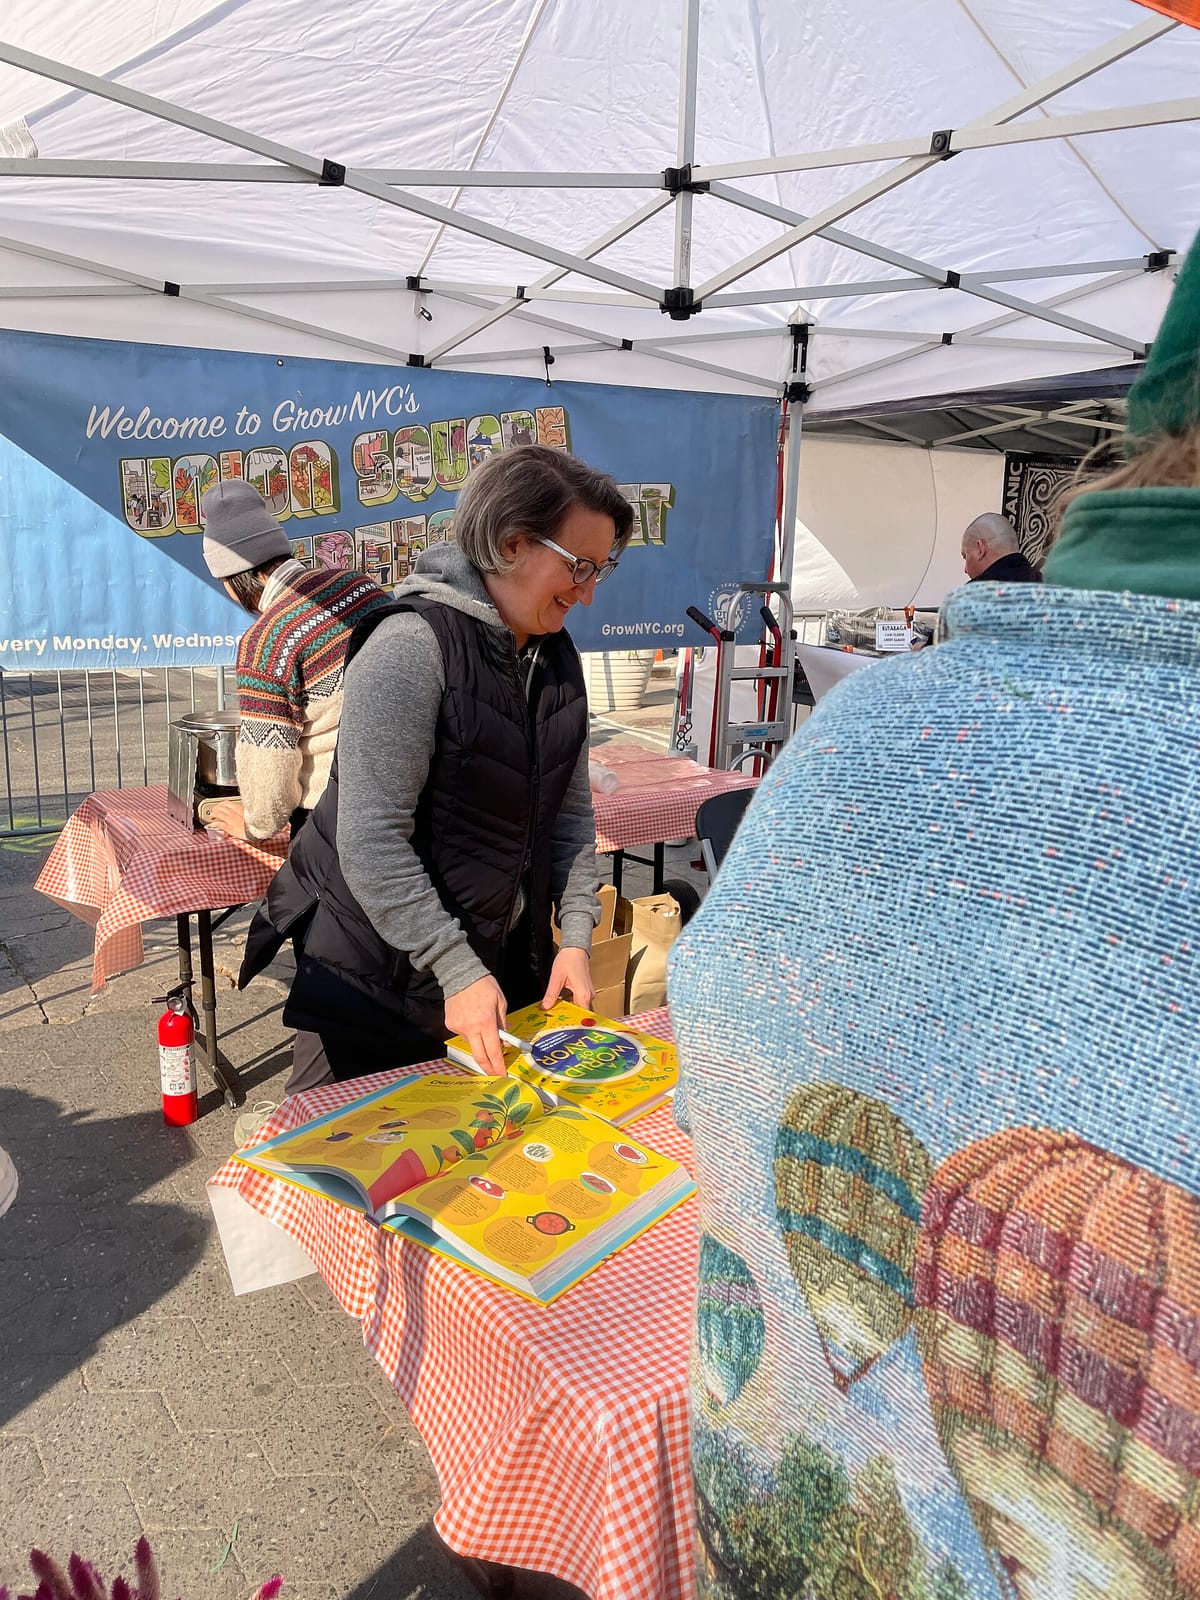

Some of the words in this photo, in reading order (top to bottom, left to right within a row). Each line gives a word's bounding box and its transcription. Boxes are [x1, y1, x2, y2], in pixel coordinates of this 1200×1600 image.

[85, 404, 227, 440] Welcome
[234, 404, 262, 437] to
[52, 634, 148, 653] Monday,
[602, 622, 684, 637] GrowNYC.org
[536, 1031, 608, 1066] FLAVOR
[565, 1045, 635, 1078] WORLD
